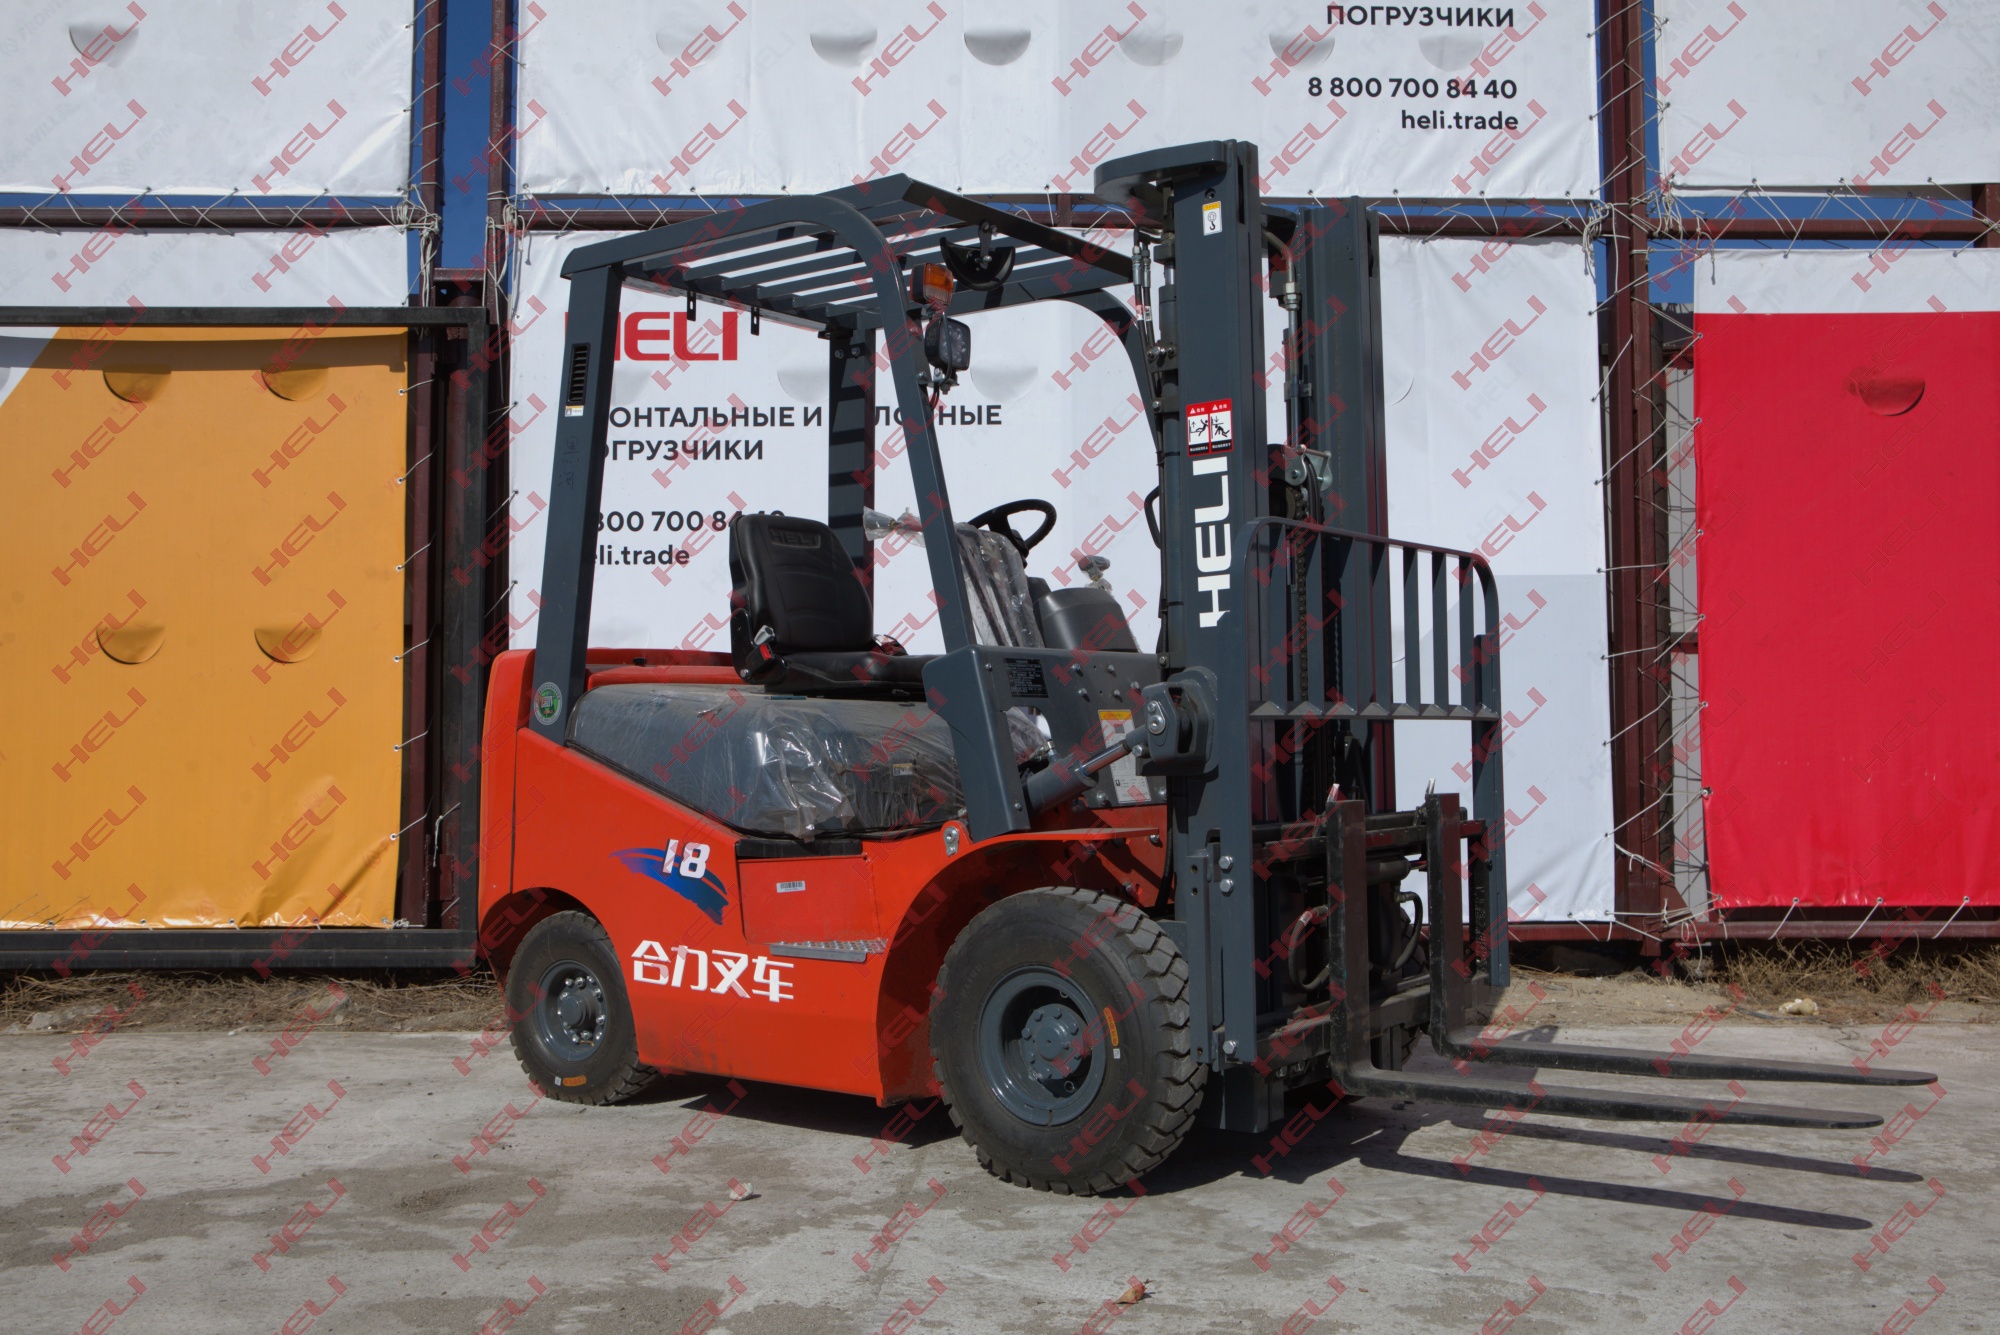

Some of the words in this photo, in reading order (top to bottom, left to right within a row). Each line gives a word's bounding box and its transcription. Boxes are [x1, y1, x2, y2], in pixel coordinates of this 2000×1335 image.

[1326, 5, 1514, 28] ПОГРУЗЧИКИ
[1307, 76, 1323, 97] 8
[1329, 76, 1382, 98] 800
[1388, 77, 1439, 98] 700
[1446, 78, 1478, 99] 84
[1483, 79, 1518, 99] 40
[1401, 108, 1519, 131] heli.trade
[609, 406, 795, 428] ОНТАЛЬНЫЕ
[803, 406, 822, 427] И
[605, 440, 763, 461] ГРУЗЧИКИ
[641, 510, 694, 532] 700
[769, 528, 818, 546] HELI
[1192, 456, 1232, 628] HELI
[595, 544, 690, 566] li.trade
[661, 838, 711, 879] 18
[630, 939, 795, 1004] 合力叉车
